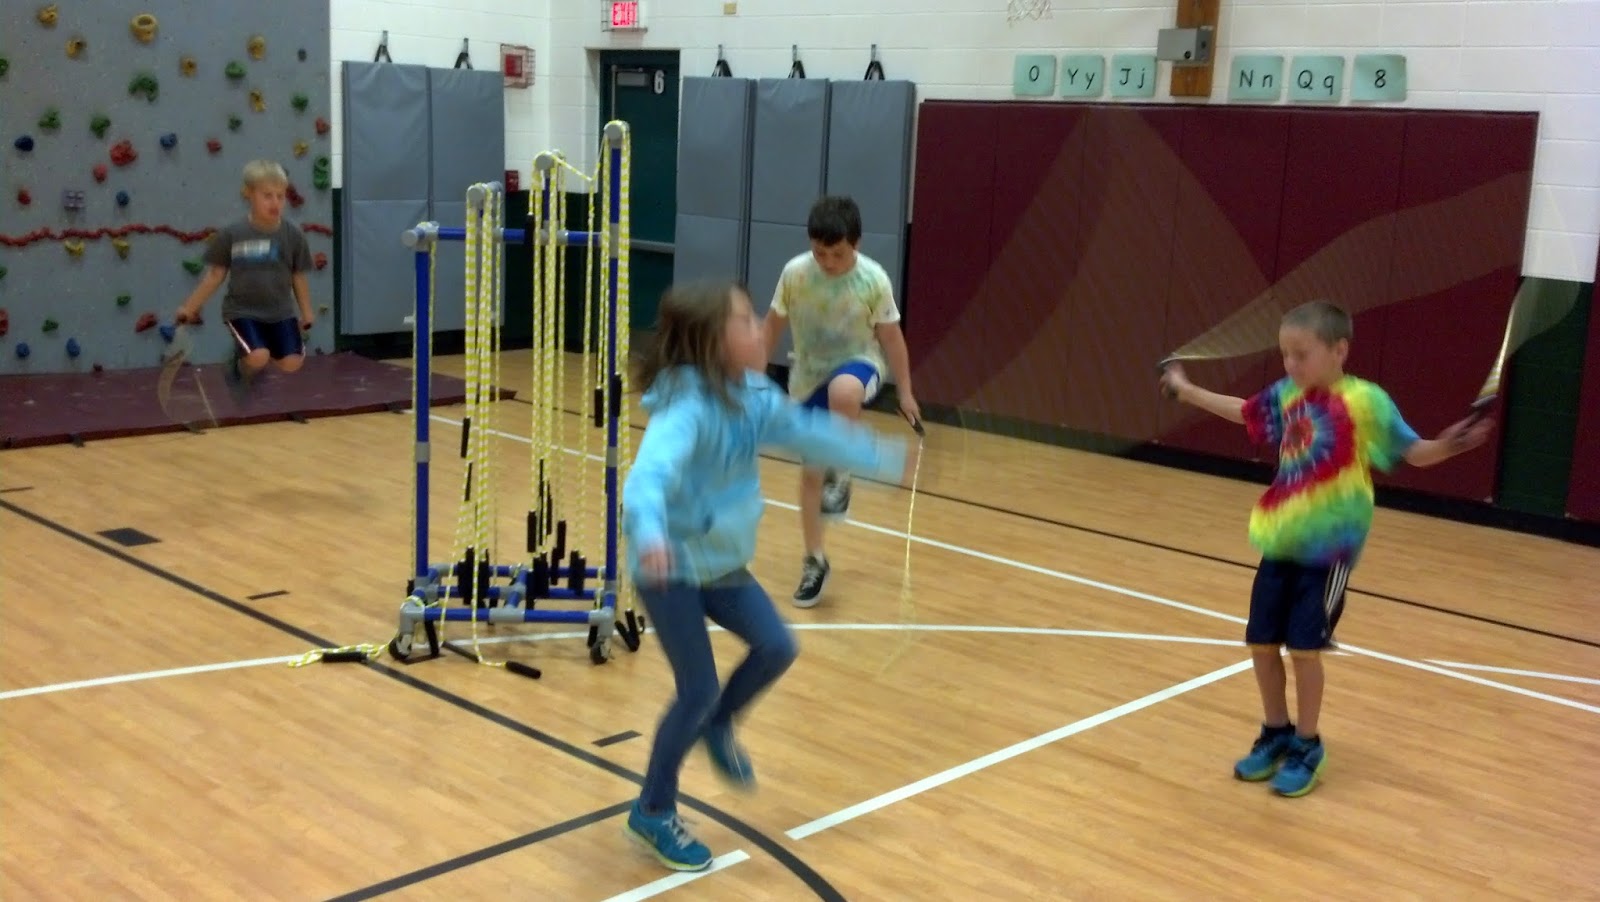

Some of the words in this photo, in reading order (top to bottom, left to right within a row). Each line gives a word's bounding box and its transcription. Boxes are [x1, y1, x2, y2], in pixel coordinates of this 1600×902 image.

[612, 2, 638, 26] EXIT
[653, 69, 665, 94] 6
[1374, 69, 1387, 89] 8
